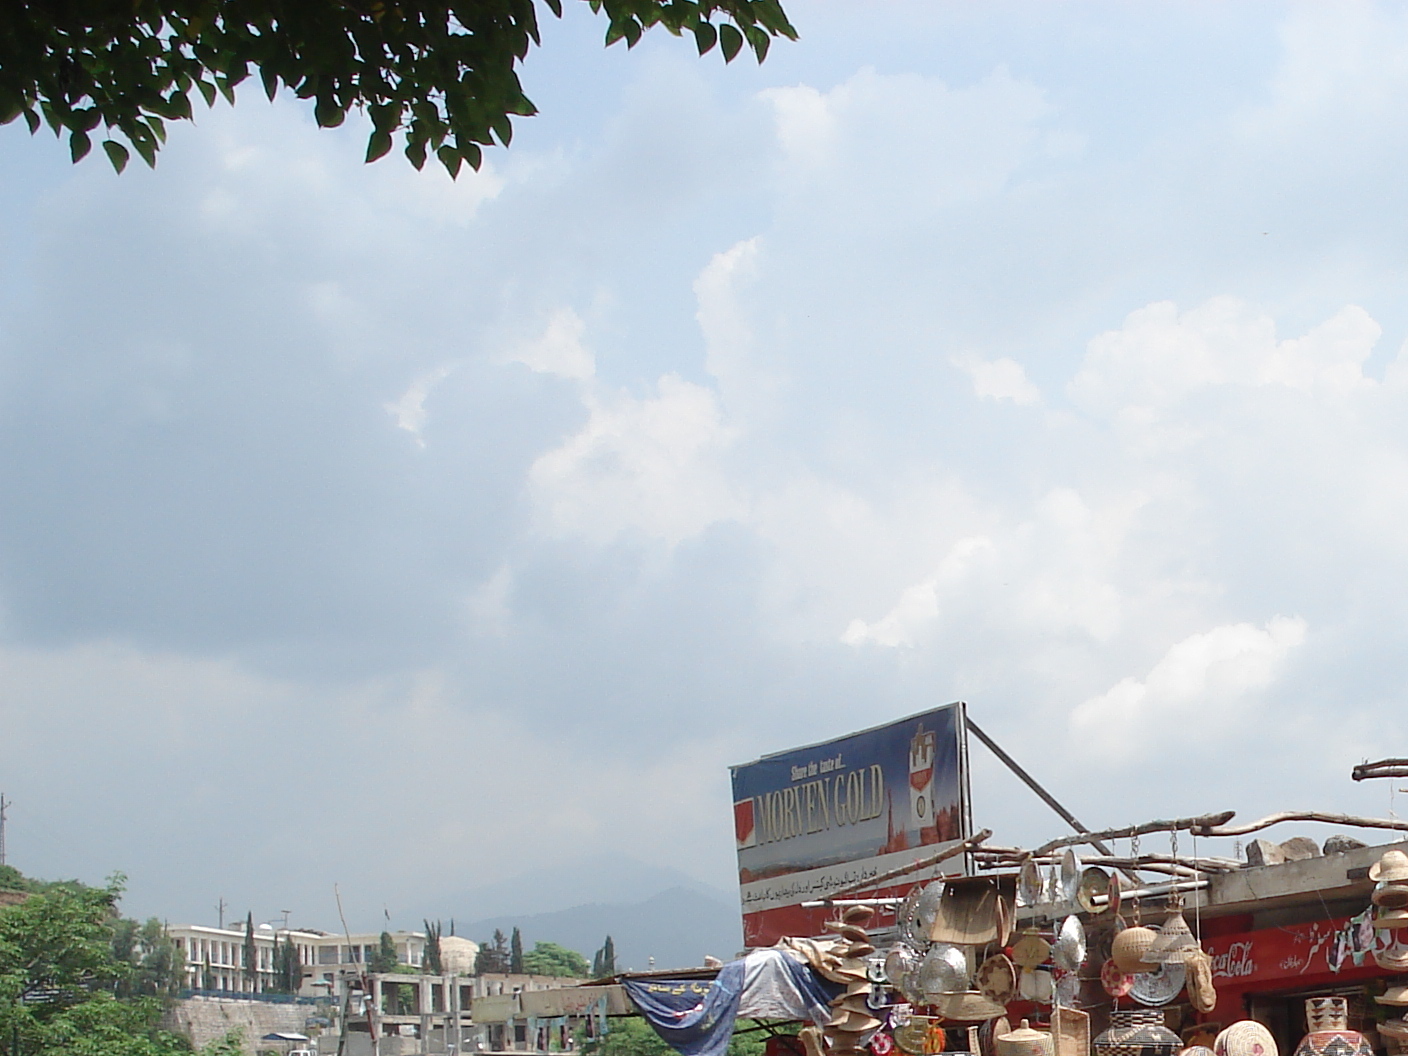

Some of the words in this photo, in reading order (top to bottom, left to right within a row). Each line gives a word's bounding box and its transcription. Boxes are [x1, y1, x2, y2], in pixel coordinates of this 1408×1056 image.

[807, 761, 818, 777] the
[757, 777, 831, 845] MORVEN
[834, 764, 884, 827] GOLD
[1208, 941, 1254, 978] ca-Cola
